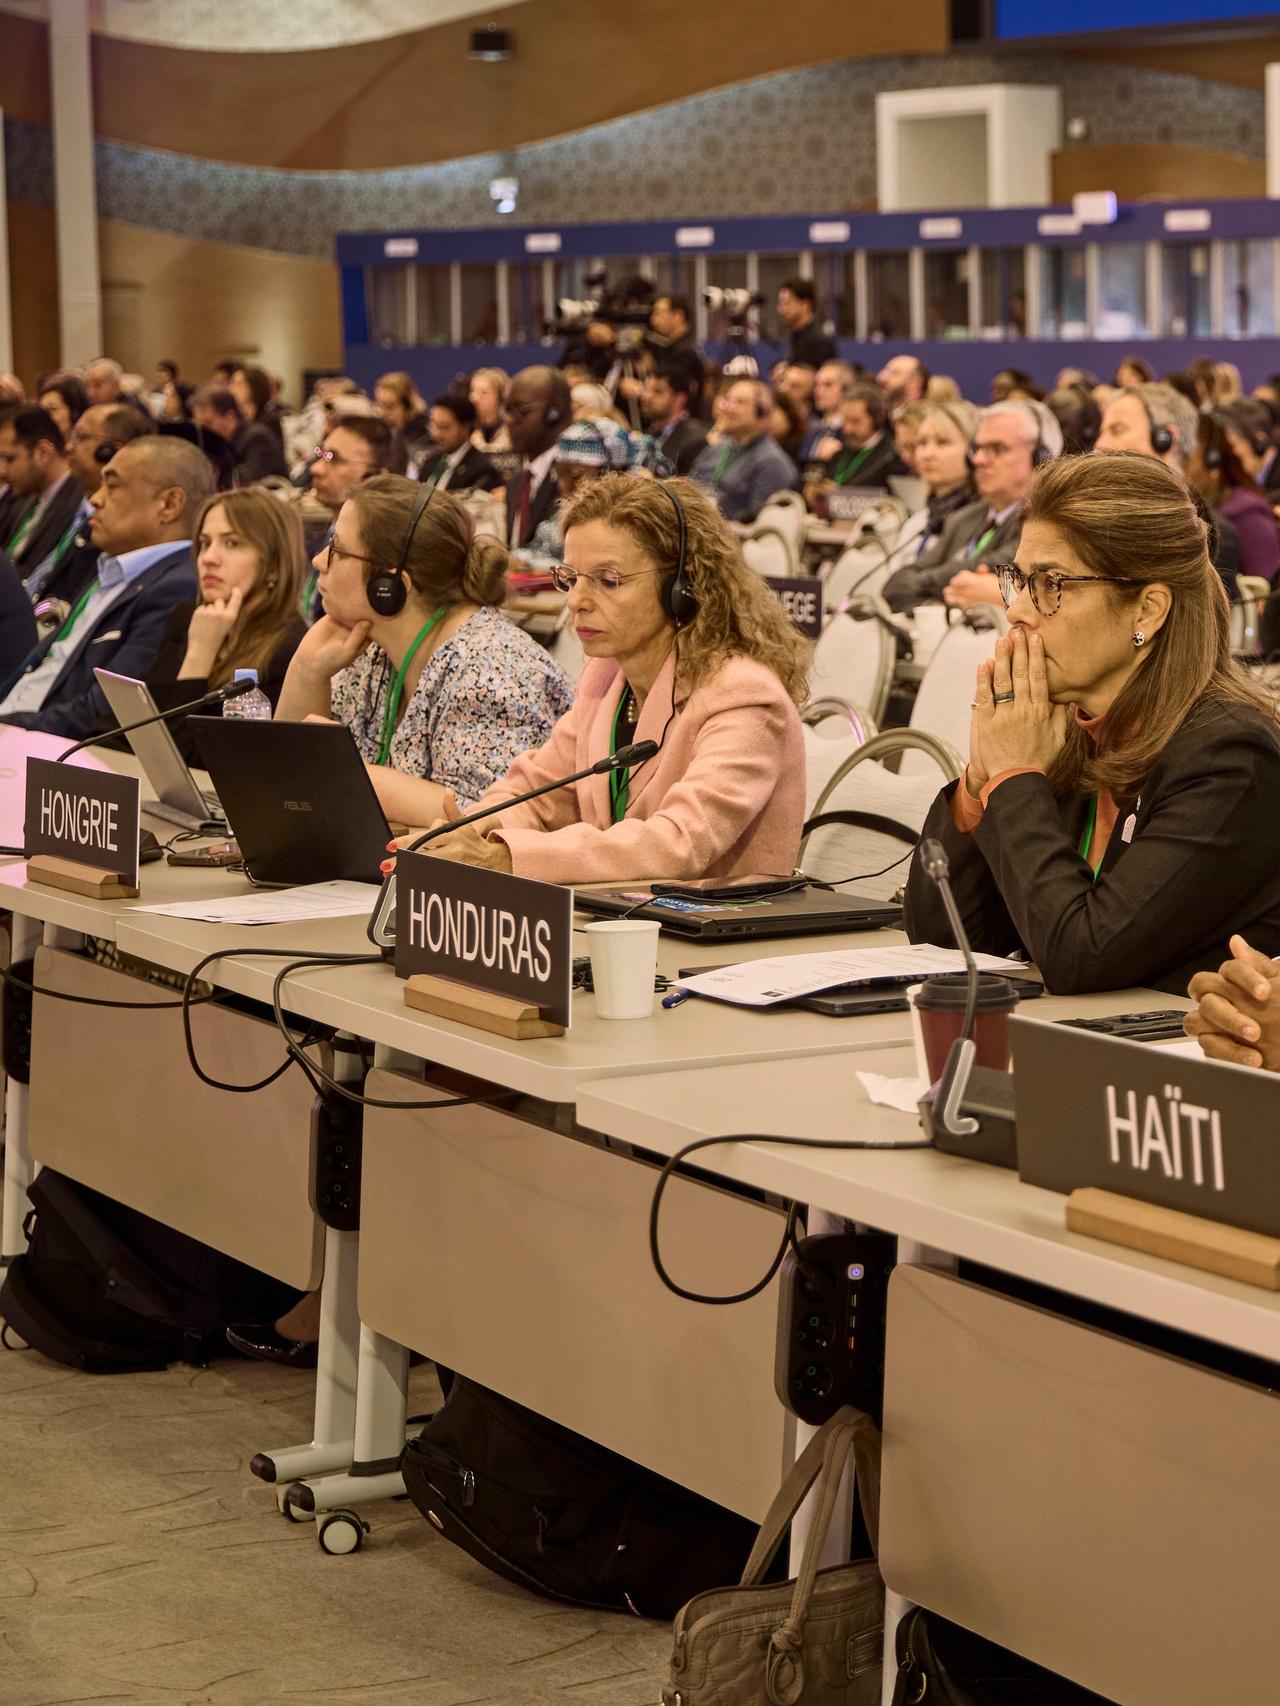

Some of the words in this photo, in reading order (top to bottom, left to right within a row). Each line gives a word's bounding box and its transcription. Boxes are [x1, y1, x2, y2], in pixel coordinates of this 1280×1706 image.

[770, 590, 816, 624] EGE
[40, 788, 119, 852] HONGRIE
[284, 801, 312, 811] ASUS
[409, 888, 551, 982] HONDURAS
[1106, 1083, 1225, 1191] HAÏTI
